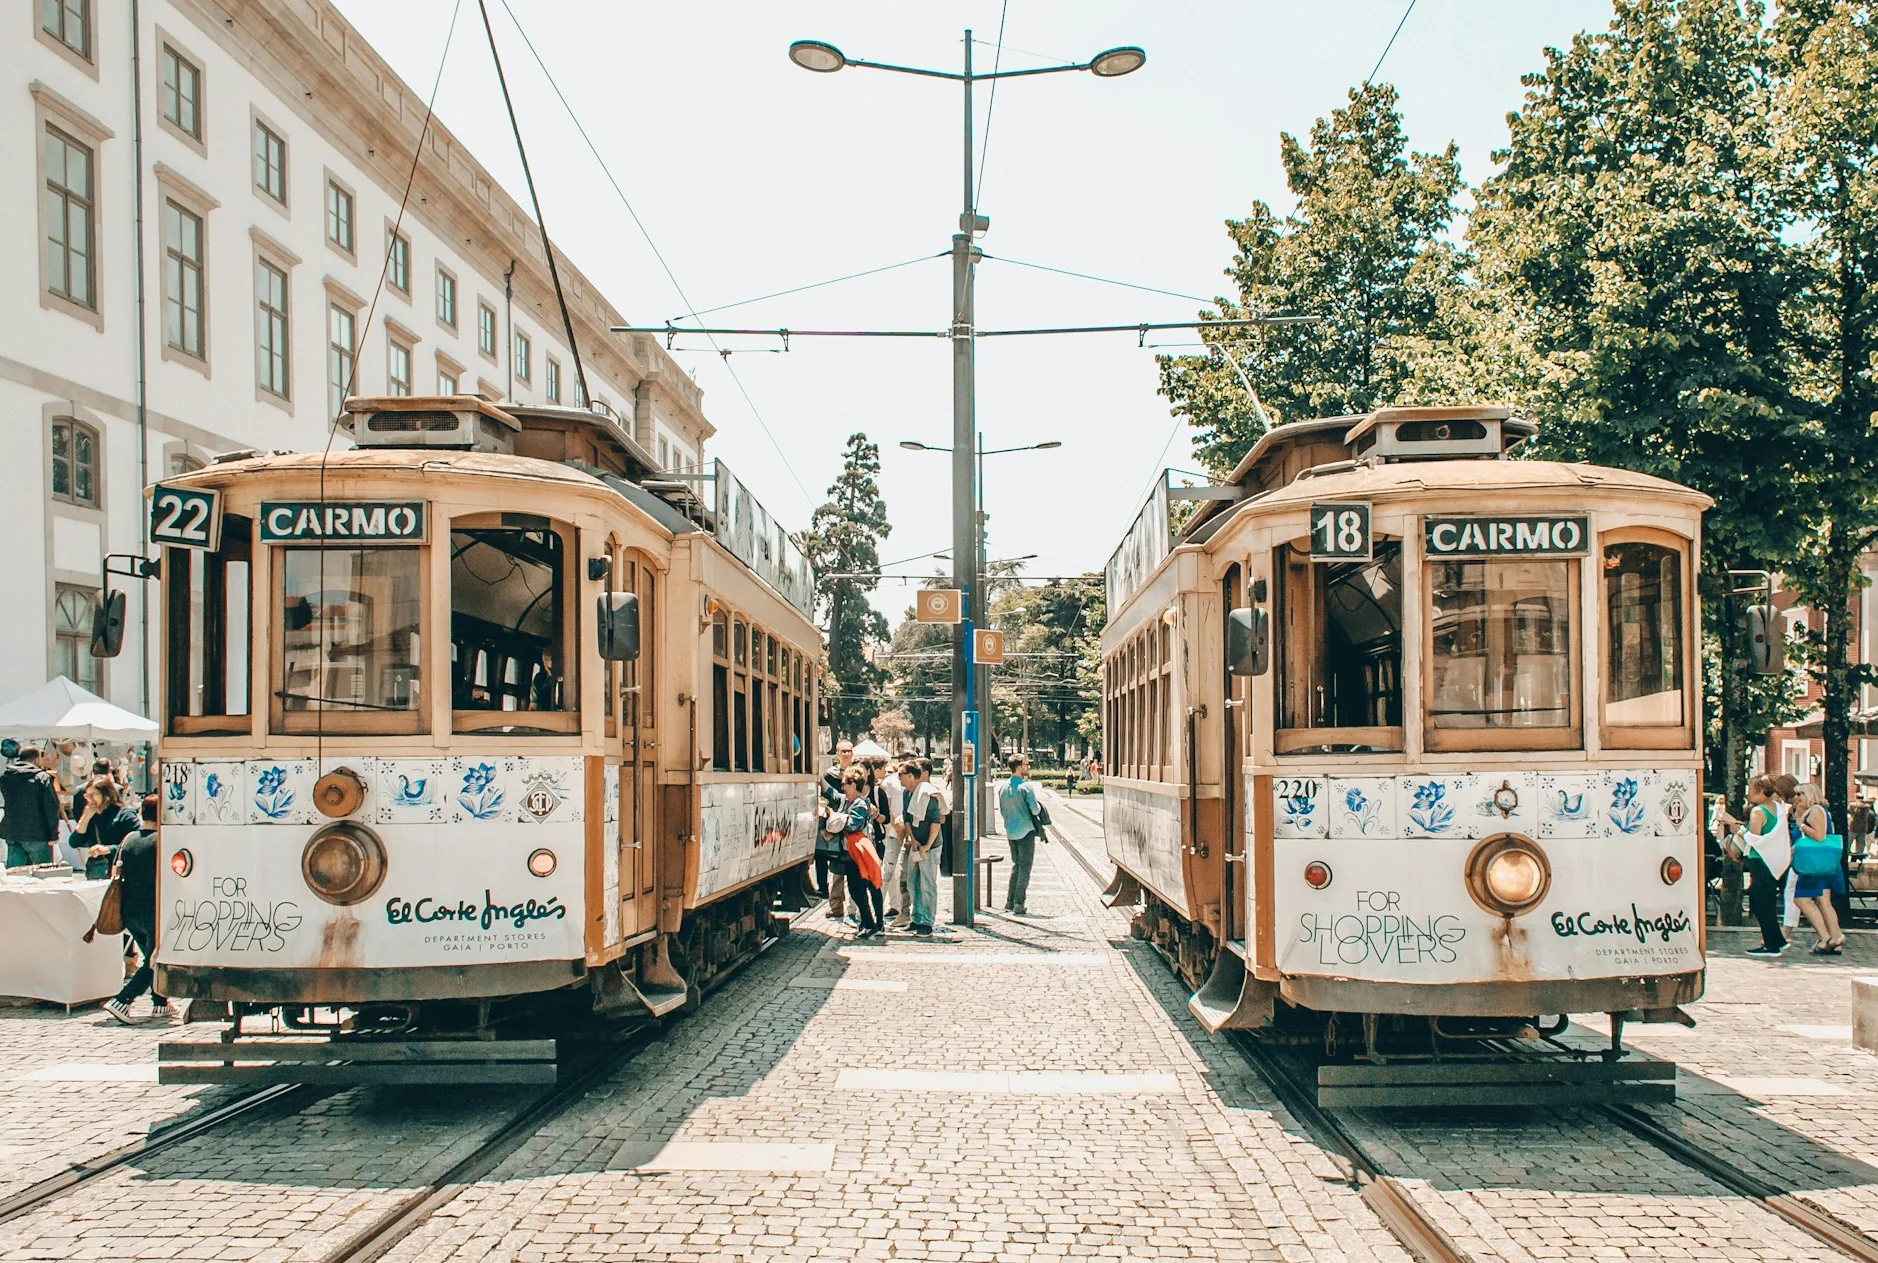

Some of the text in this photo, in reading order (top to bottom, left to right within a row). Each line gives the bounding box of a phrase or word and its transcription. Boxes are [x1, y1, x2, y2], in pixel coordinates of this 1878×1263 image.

[155, 494, 209, 541] 22
[268, 507, 416, 536] CARMO
[1316, 510, 1362, 552] 18
[1432, 521, 1581, 551] CARMO
[164, 764, 188, 783] 218
[1277, 779, 1318, 799] 220
[212, 877, 247, 897] FOR
[170, 899, 303, 932] SHOPPING
[386, 889, 566, 930] El Corte Inglés
[1356, 891, 1401, 912] FOR
[172, 921, 286, 952] LOVERS
[424, 932, 546, 944] DEPARTMENT STORES
[1299, 912, 1466, 944] SHOPPING
[1551, 911, 1579, 938] El
[1577, 911, 1633, 936] Corte
[443, 942, 529, 952] GAIA PORTO
[1319, 934, 1457, 965] LOVERS
[1595, 946, 1689, 957] DEPARTMENT STORES
[1614, 956, 1679, 965] GAIA PORTO
